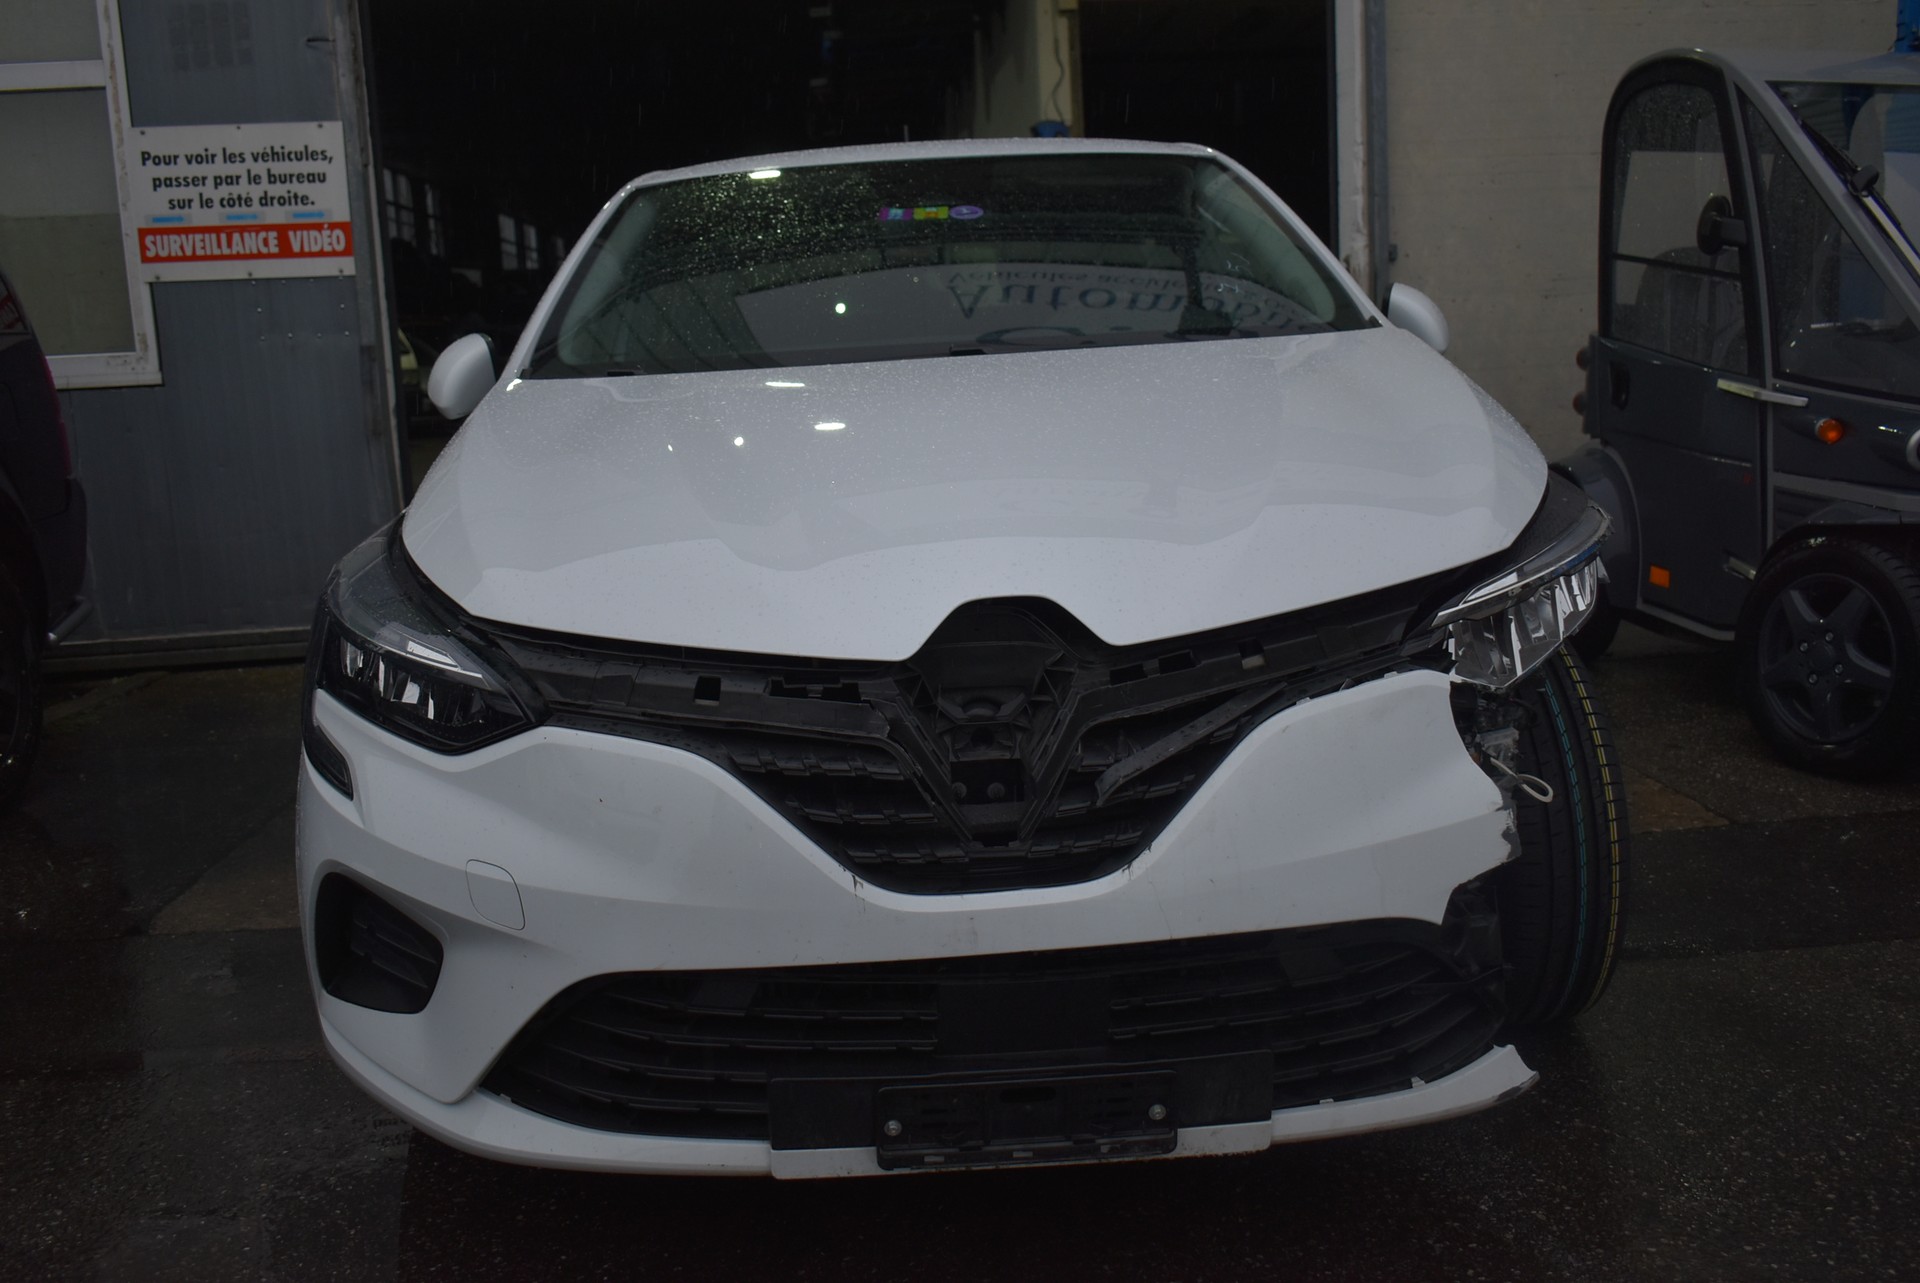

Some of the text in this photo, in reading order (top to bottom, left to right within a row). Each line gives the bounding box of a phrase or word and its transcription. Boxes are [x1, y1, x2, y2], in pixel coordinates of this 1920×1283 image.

[140, 145, 333, 167] Pour voir les véhicules,
[152, 168, 327, 191] passer par le bureau
[168, 190, 315, 210] sur le côté droite.
[145, 224, 346, 258] SURVEILLANCE VIDÉO
